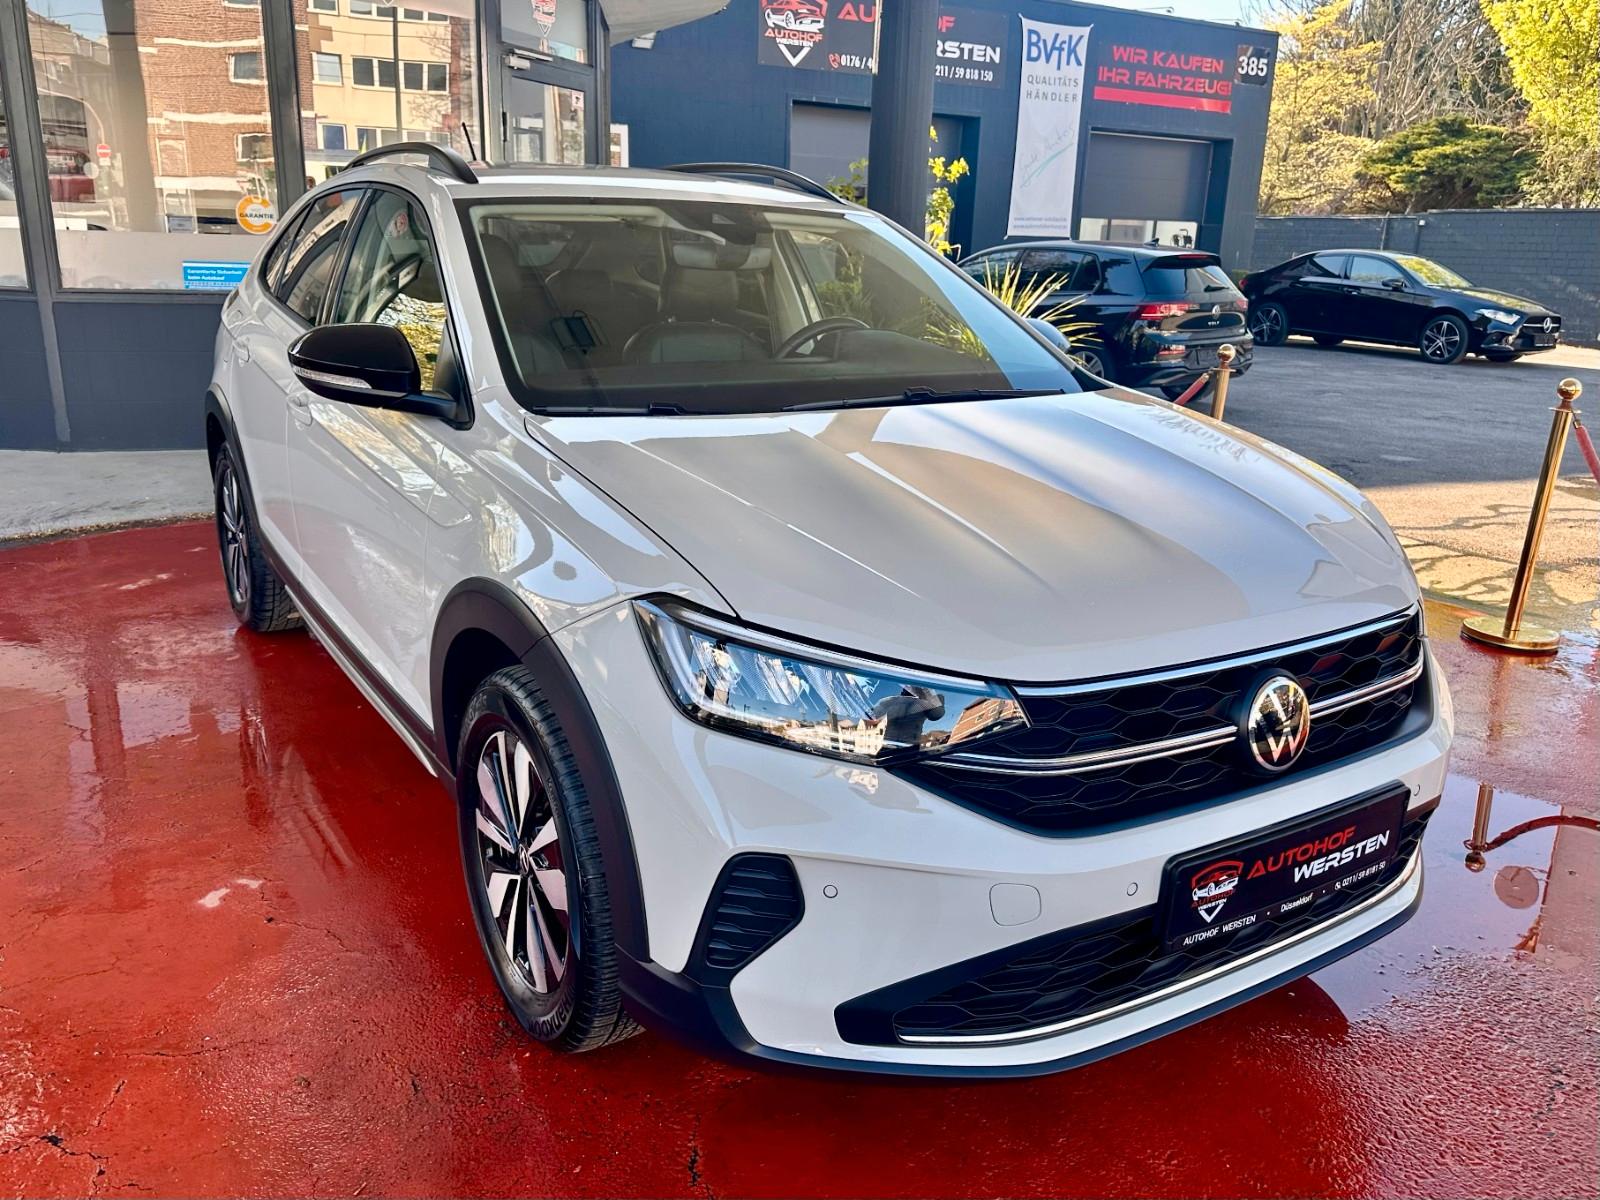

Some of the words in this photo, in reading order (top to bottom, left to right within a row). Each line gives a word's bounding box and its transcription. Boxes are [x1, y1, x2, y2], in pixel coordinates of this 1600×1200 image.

[837, 2, 876, 22] AU
[764, 28, 823, 43] AUTOHOF
[936, 39, 1001, 64] STEN
[1026, 28, 1084, 71] BVfK
[1112, 45, 1148, 65] WIR
[1153, 50, 1224, 75] KAUFEN
[841, 54, 861, 68] 0176
[1237, 55, 1268, 77] 385
[935, 64, 948, 77] 211
[955, 66, 964, 78] 59
[965, 68, 979, 80] 818
[980, 69, 993, 82] 150
[1027, 74, 1079, 88] QUALITÄTS
[1098, 65, 1131, 85] IHR
[1134, 70, 1232, 97] FAHRZEUG!
[1025, 88, 1078, 103] HÄNDLER
[1247, 825, 1357, 881] AUTOHOF
[1294, 829, 1390, 883] WERSTEN
[1191, 888, 1236, 908] AUTOHOF
[1183, 926, 1220, 946] AUTOHOF
[1222, 914, 1257, 933] WERSTEN
[1280, 892, 1314, 913] Düsseldorf
